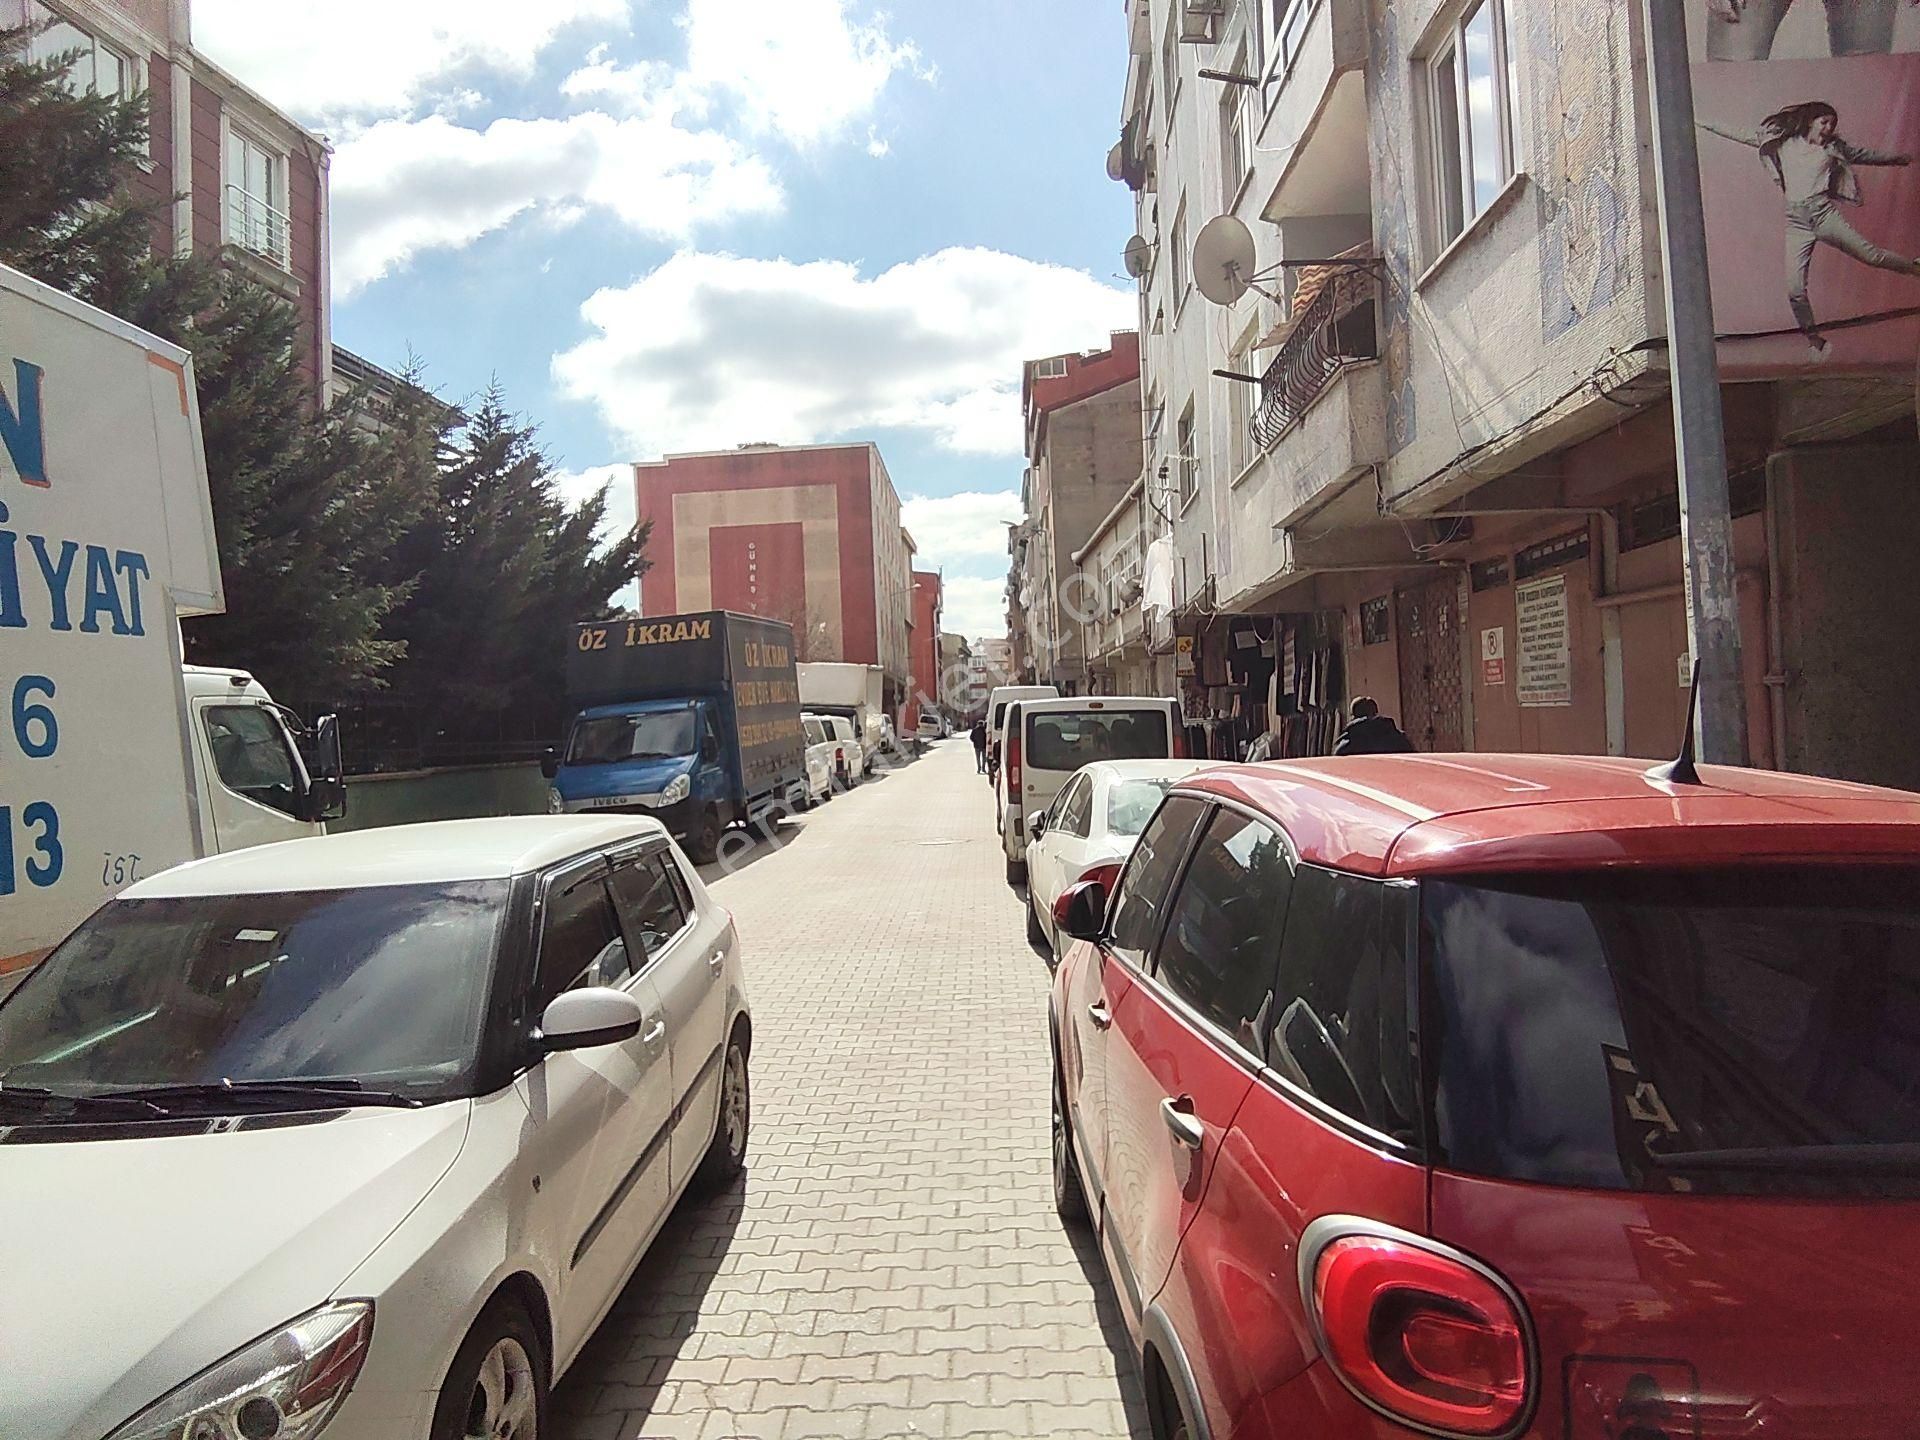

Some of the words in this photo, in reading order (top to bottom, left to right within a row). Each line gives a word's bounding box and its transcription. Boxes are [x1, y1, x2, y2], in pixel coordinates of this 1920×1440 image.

[578, 628, 607, 651] ÖZ
[624, 619, 711, 647] İKRAM
[745, 638, 759, 668] ÖZ
[761, 637, 789, 668] İKRAM
[593, 797, 628, 806] IVECO
